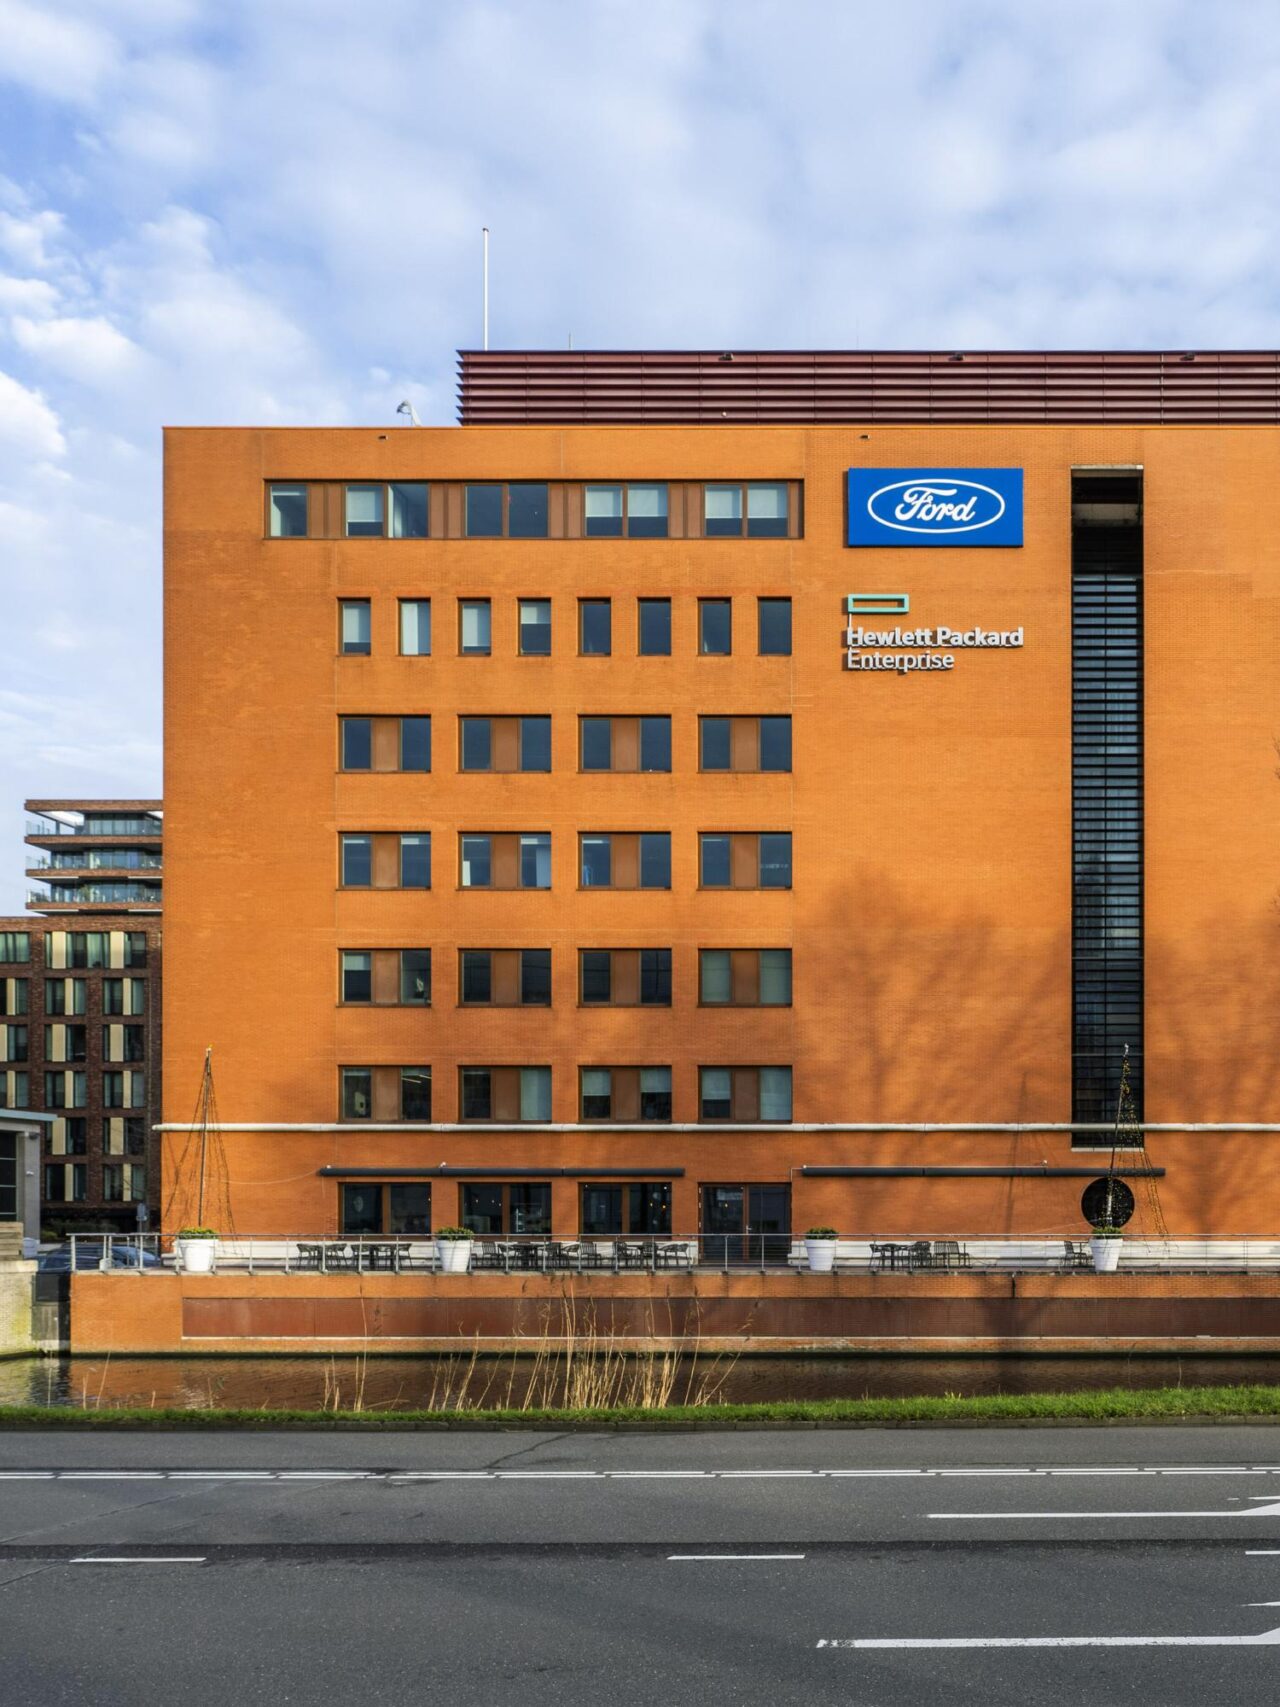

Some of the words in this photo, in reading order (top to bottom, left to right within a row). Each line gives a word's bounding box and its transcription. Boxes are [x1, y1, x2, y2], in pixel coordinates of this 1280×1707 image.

[895, 487, 977, 521] Ford
[847, 626, 932, 646] Hewlett
[937, 626, 1024, 646] Packard
[847, 650, 955, 672] Enterprise
